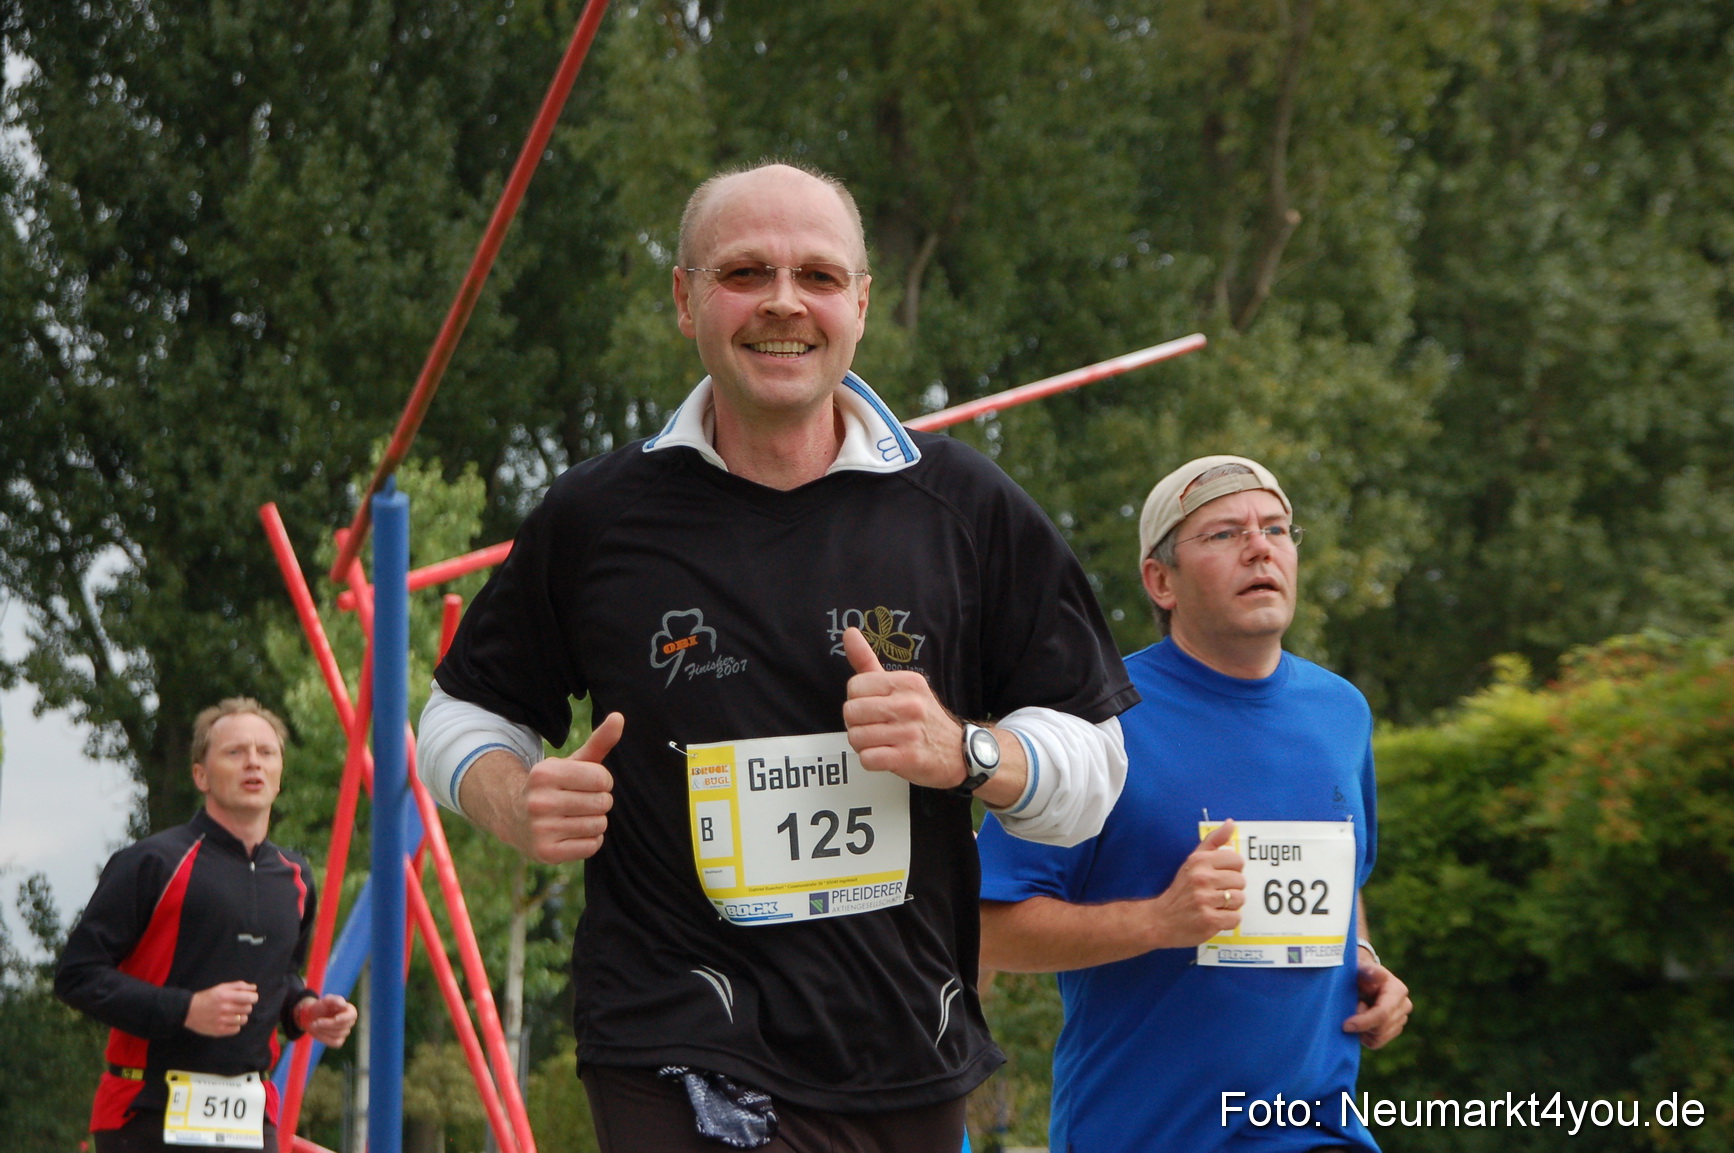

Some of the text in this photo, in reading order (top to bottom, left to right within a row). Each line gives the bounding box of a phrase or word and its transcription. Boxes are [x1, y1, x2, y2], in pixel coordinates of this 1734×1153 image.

[663, 634, 698, 654] OBI
[684, 655, 735, 680] Finisher
[716, 659, 748, 679] 2007
[748, 751, 849, 791] Gabriel
[700, 816, 714, 842] B
[777, 806, 876, 861] 125
[1248, 836, 1302, 867] Eugen
[832, 882, 903, 904] PFLEIDERER
[1263, 879, 1329, 915] 682
[725, 902, 778, 917] BOCK
[203, 1096, 246, 1119] 510
